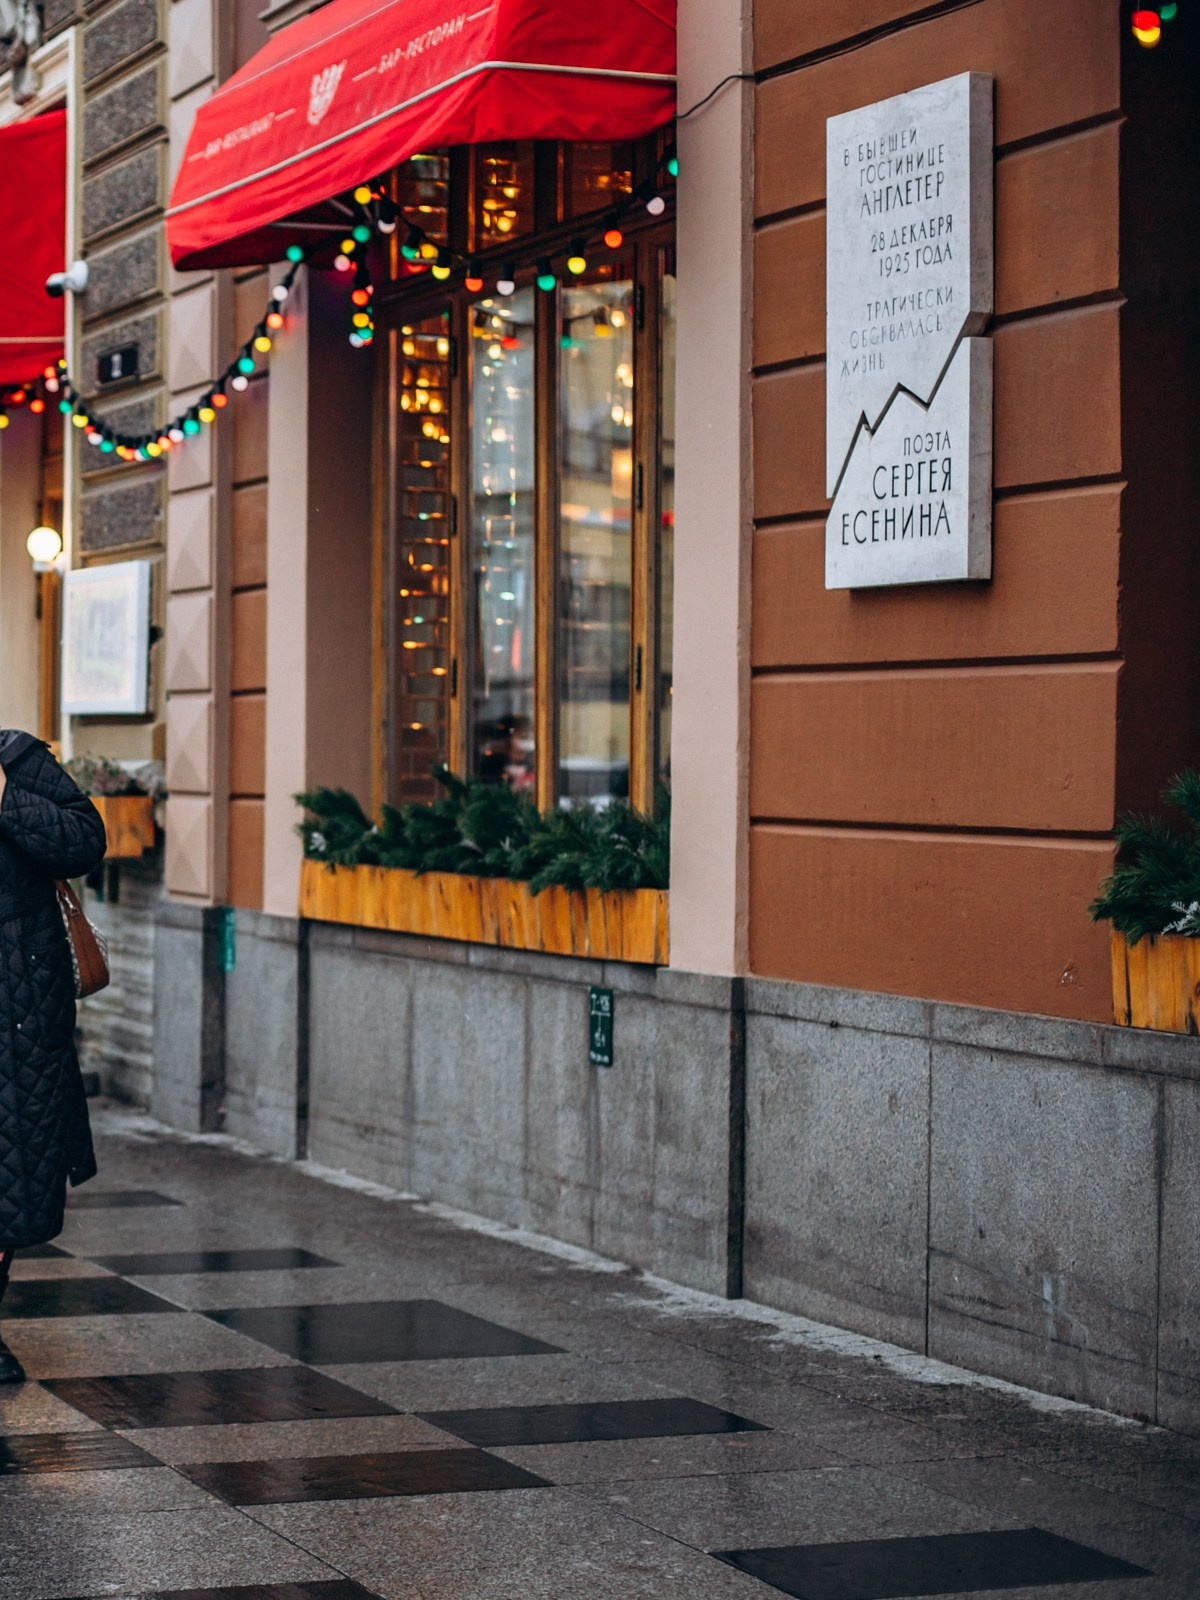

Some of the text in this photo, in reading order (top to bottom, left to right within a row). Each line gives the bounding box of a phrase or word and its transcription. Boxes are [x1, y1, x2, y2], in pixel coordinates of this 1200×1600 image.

[843, 126, 917, 167] В БЫВШЕЙ
[860, 143, 944, 187] ГОСТИНИЦЕ
[860, 170, 945, 218] АНГЛЕТЕР
[870, 214, 953, 253] 28 ДЕКАБРЯ
[879, 242, 953, 278] 1925 ГОДА
[867, 286, 953, 321] ТРАГИЧЕСКИ
[850, 313, 943, 349] ОБОРВАЛАСЬ
[841, 352, 885, 377] ЖИЗНЬ
[903, 430, 951, 456] ПОЭТА
[873, 457, 952, 500] СЕРГЕЯ
[842, 499, 951, 545] ЕСЕНИНА
